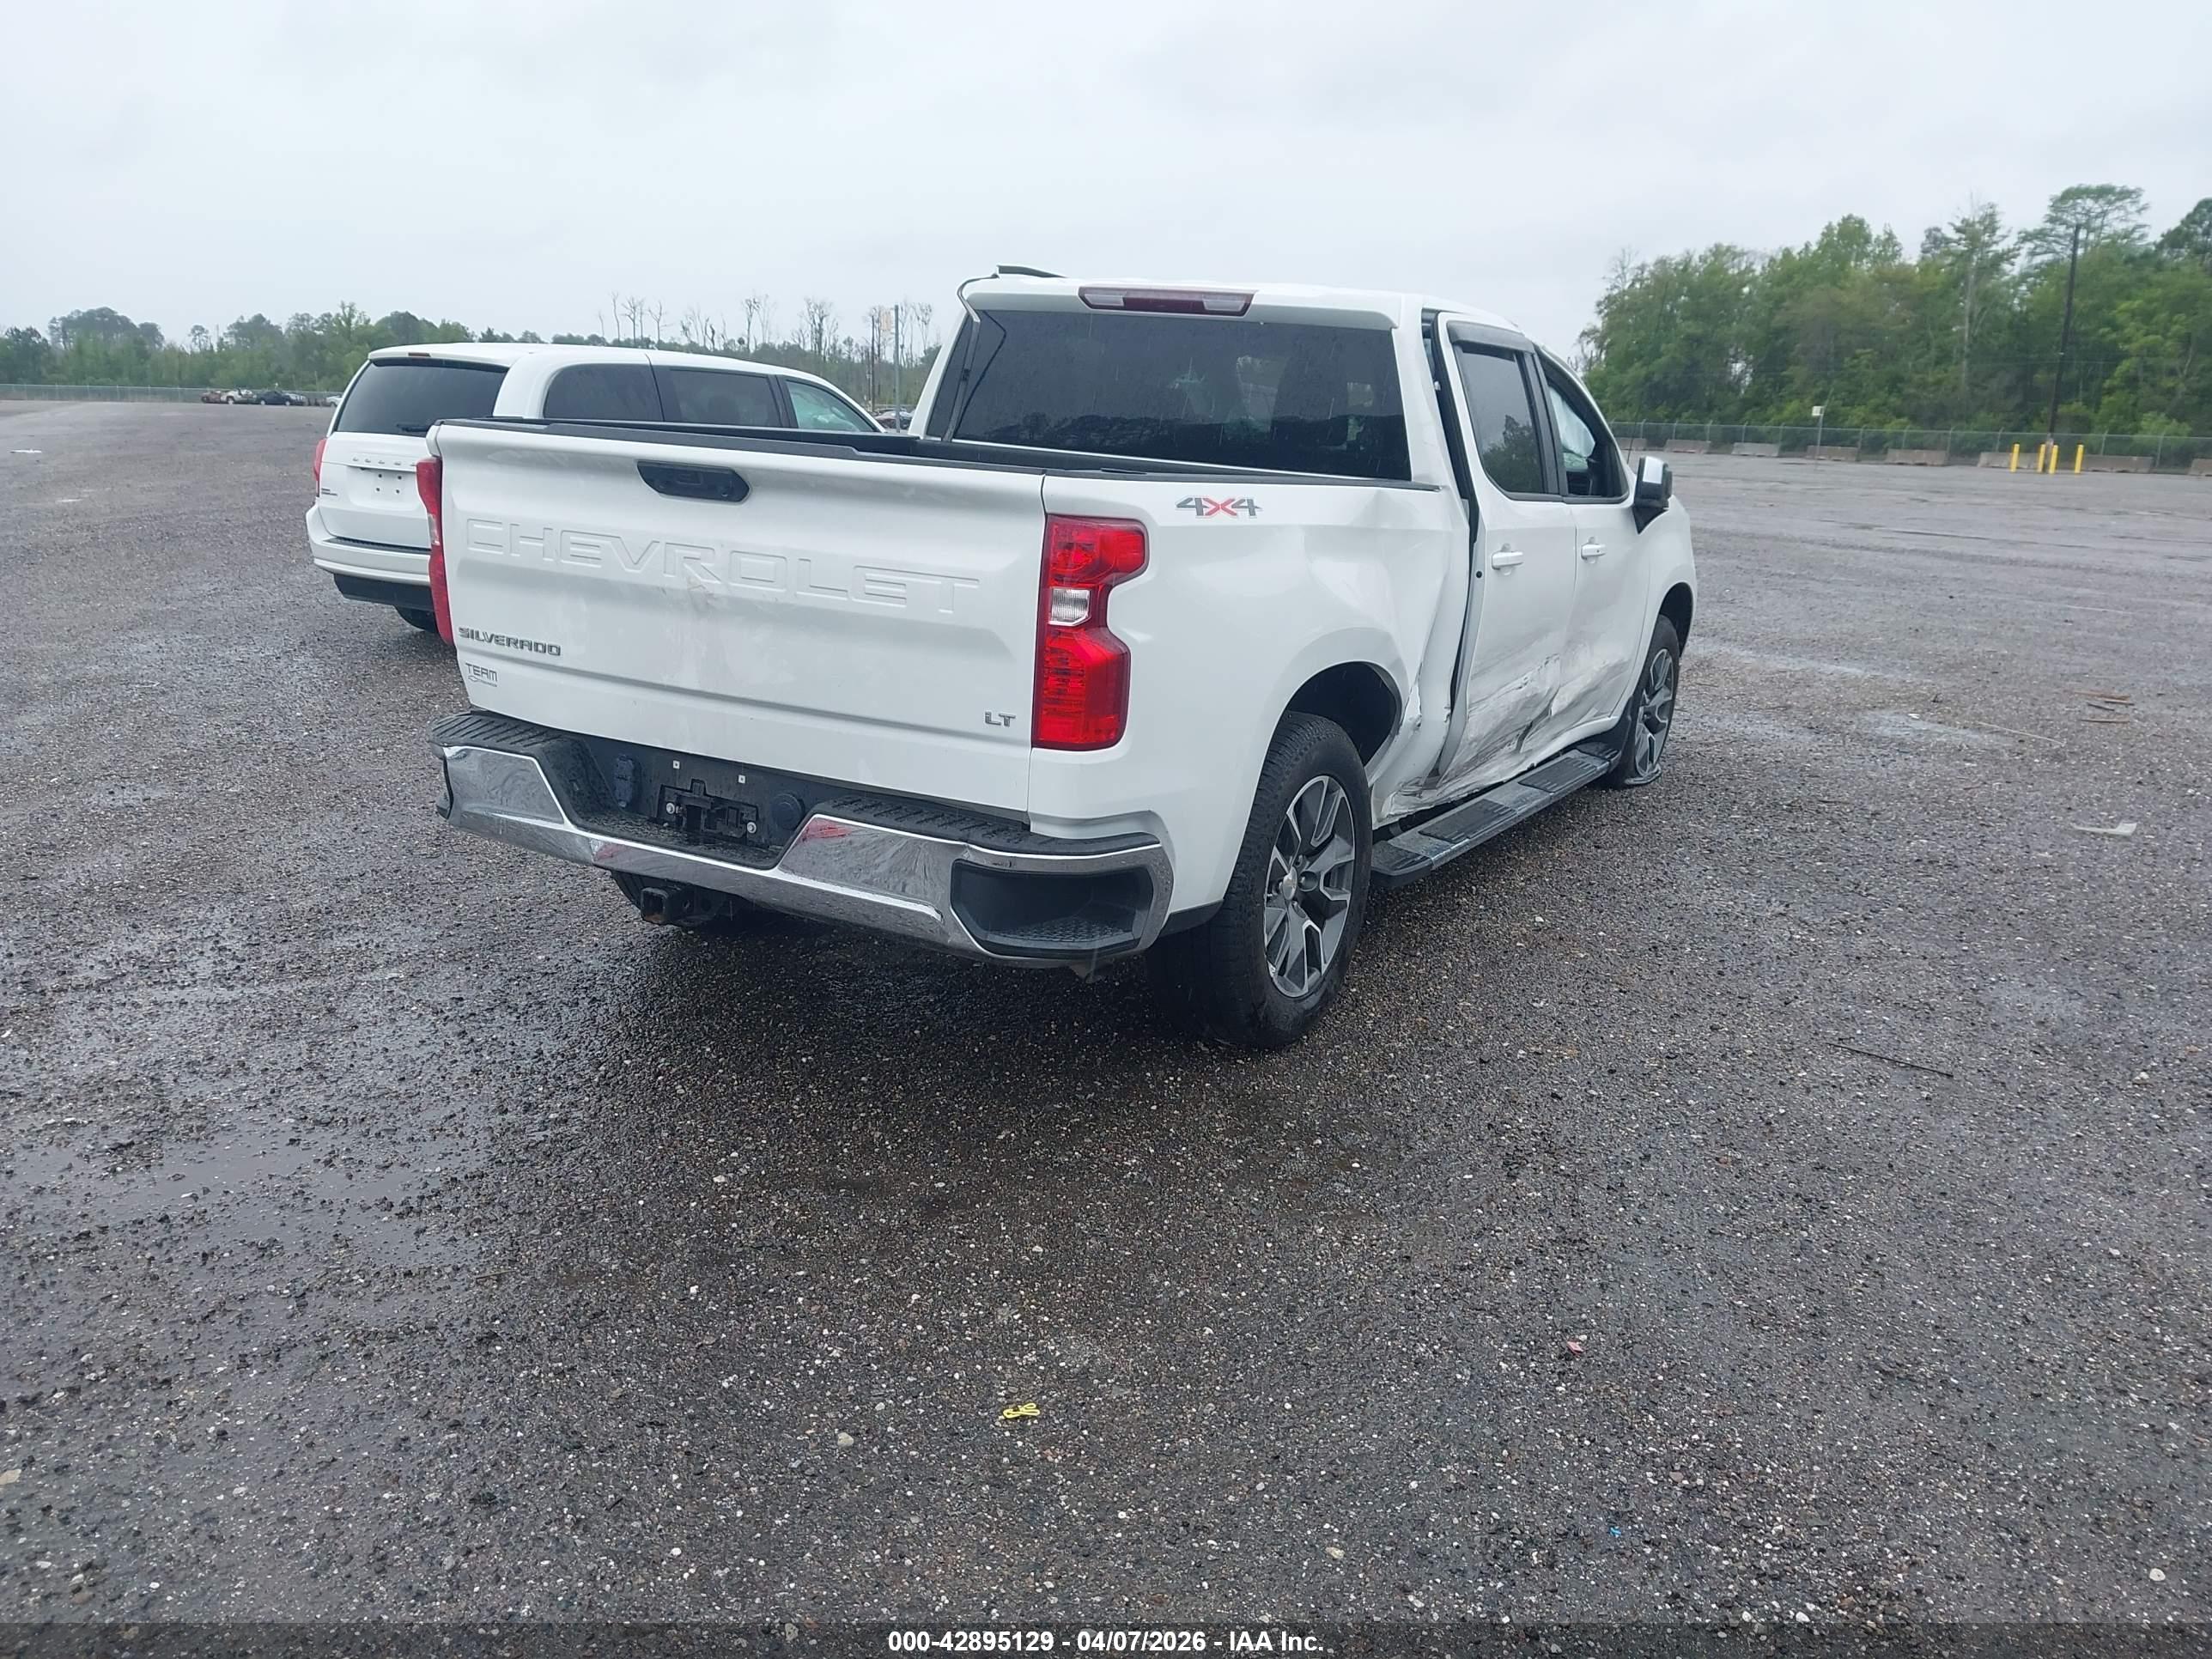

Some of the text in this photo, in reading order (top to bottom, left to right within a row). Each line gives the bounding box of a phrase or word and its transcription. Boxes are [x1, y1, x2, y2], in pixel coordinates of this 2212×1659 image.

[466, 518, 980, 614] CHEVROLET
[458, 626, 562, 657] SILVERADO
[465, 662, 498, 682] TEAM
[984, 711, 1017, 728] LT
